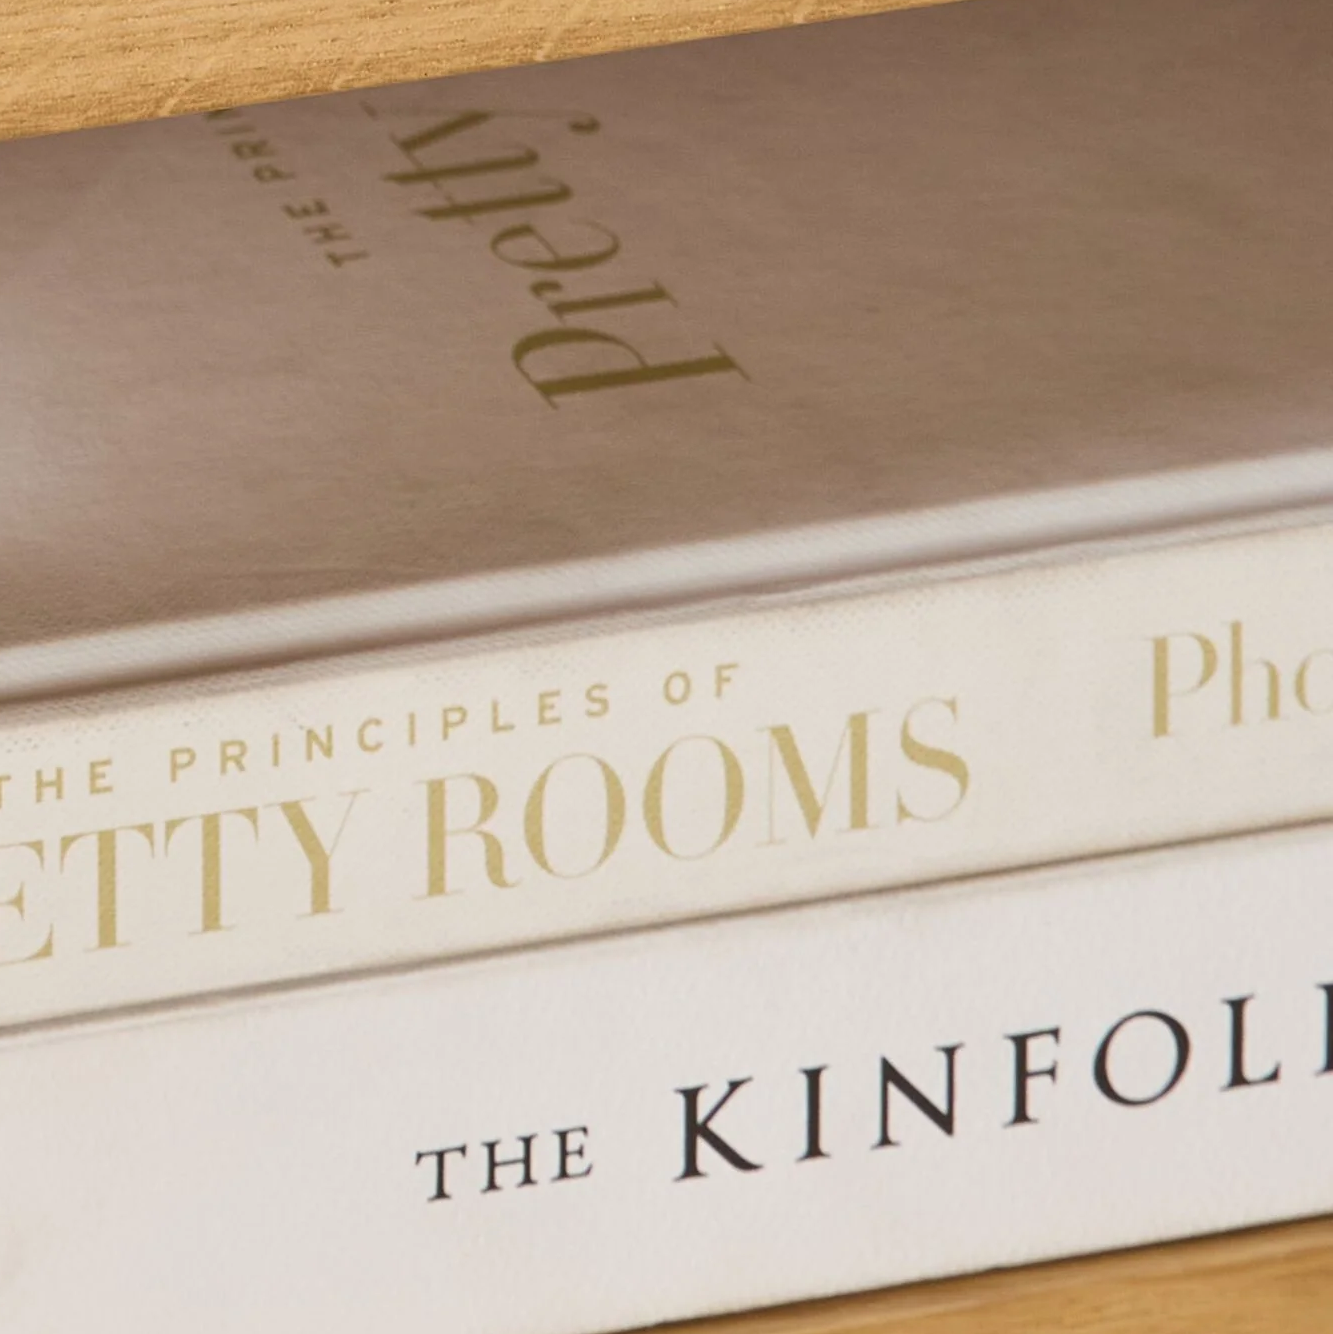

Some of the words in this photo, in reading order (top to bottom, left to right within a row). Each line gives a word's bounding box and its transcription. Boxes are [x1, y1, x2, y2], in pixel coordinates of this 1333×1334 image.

[281, 198, 371, 268] THE
[359, 100, 752, 410] Pretty
[170, 683, 611, 783] PRINCIPLES
[663, 663, 740, 706] OF
[413, 697, 971, 900] ROOMS
[415, 1126, 594, 1202] THE
